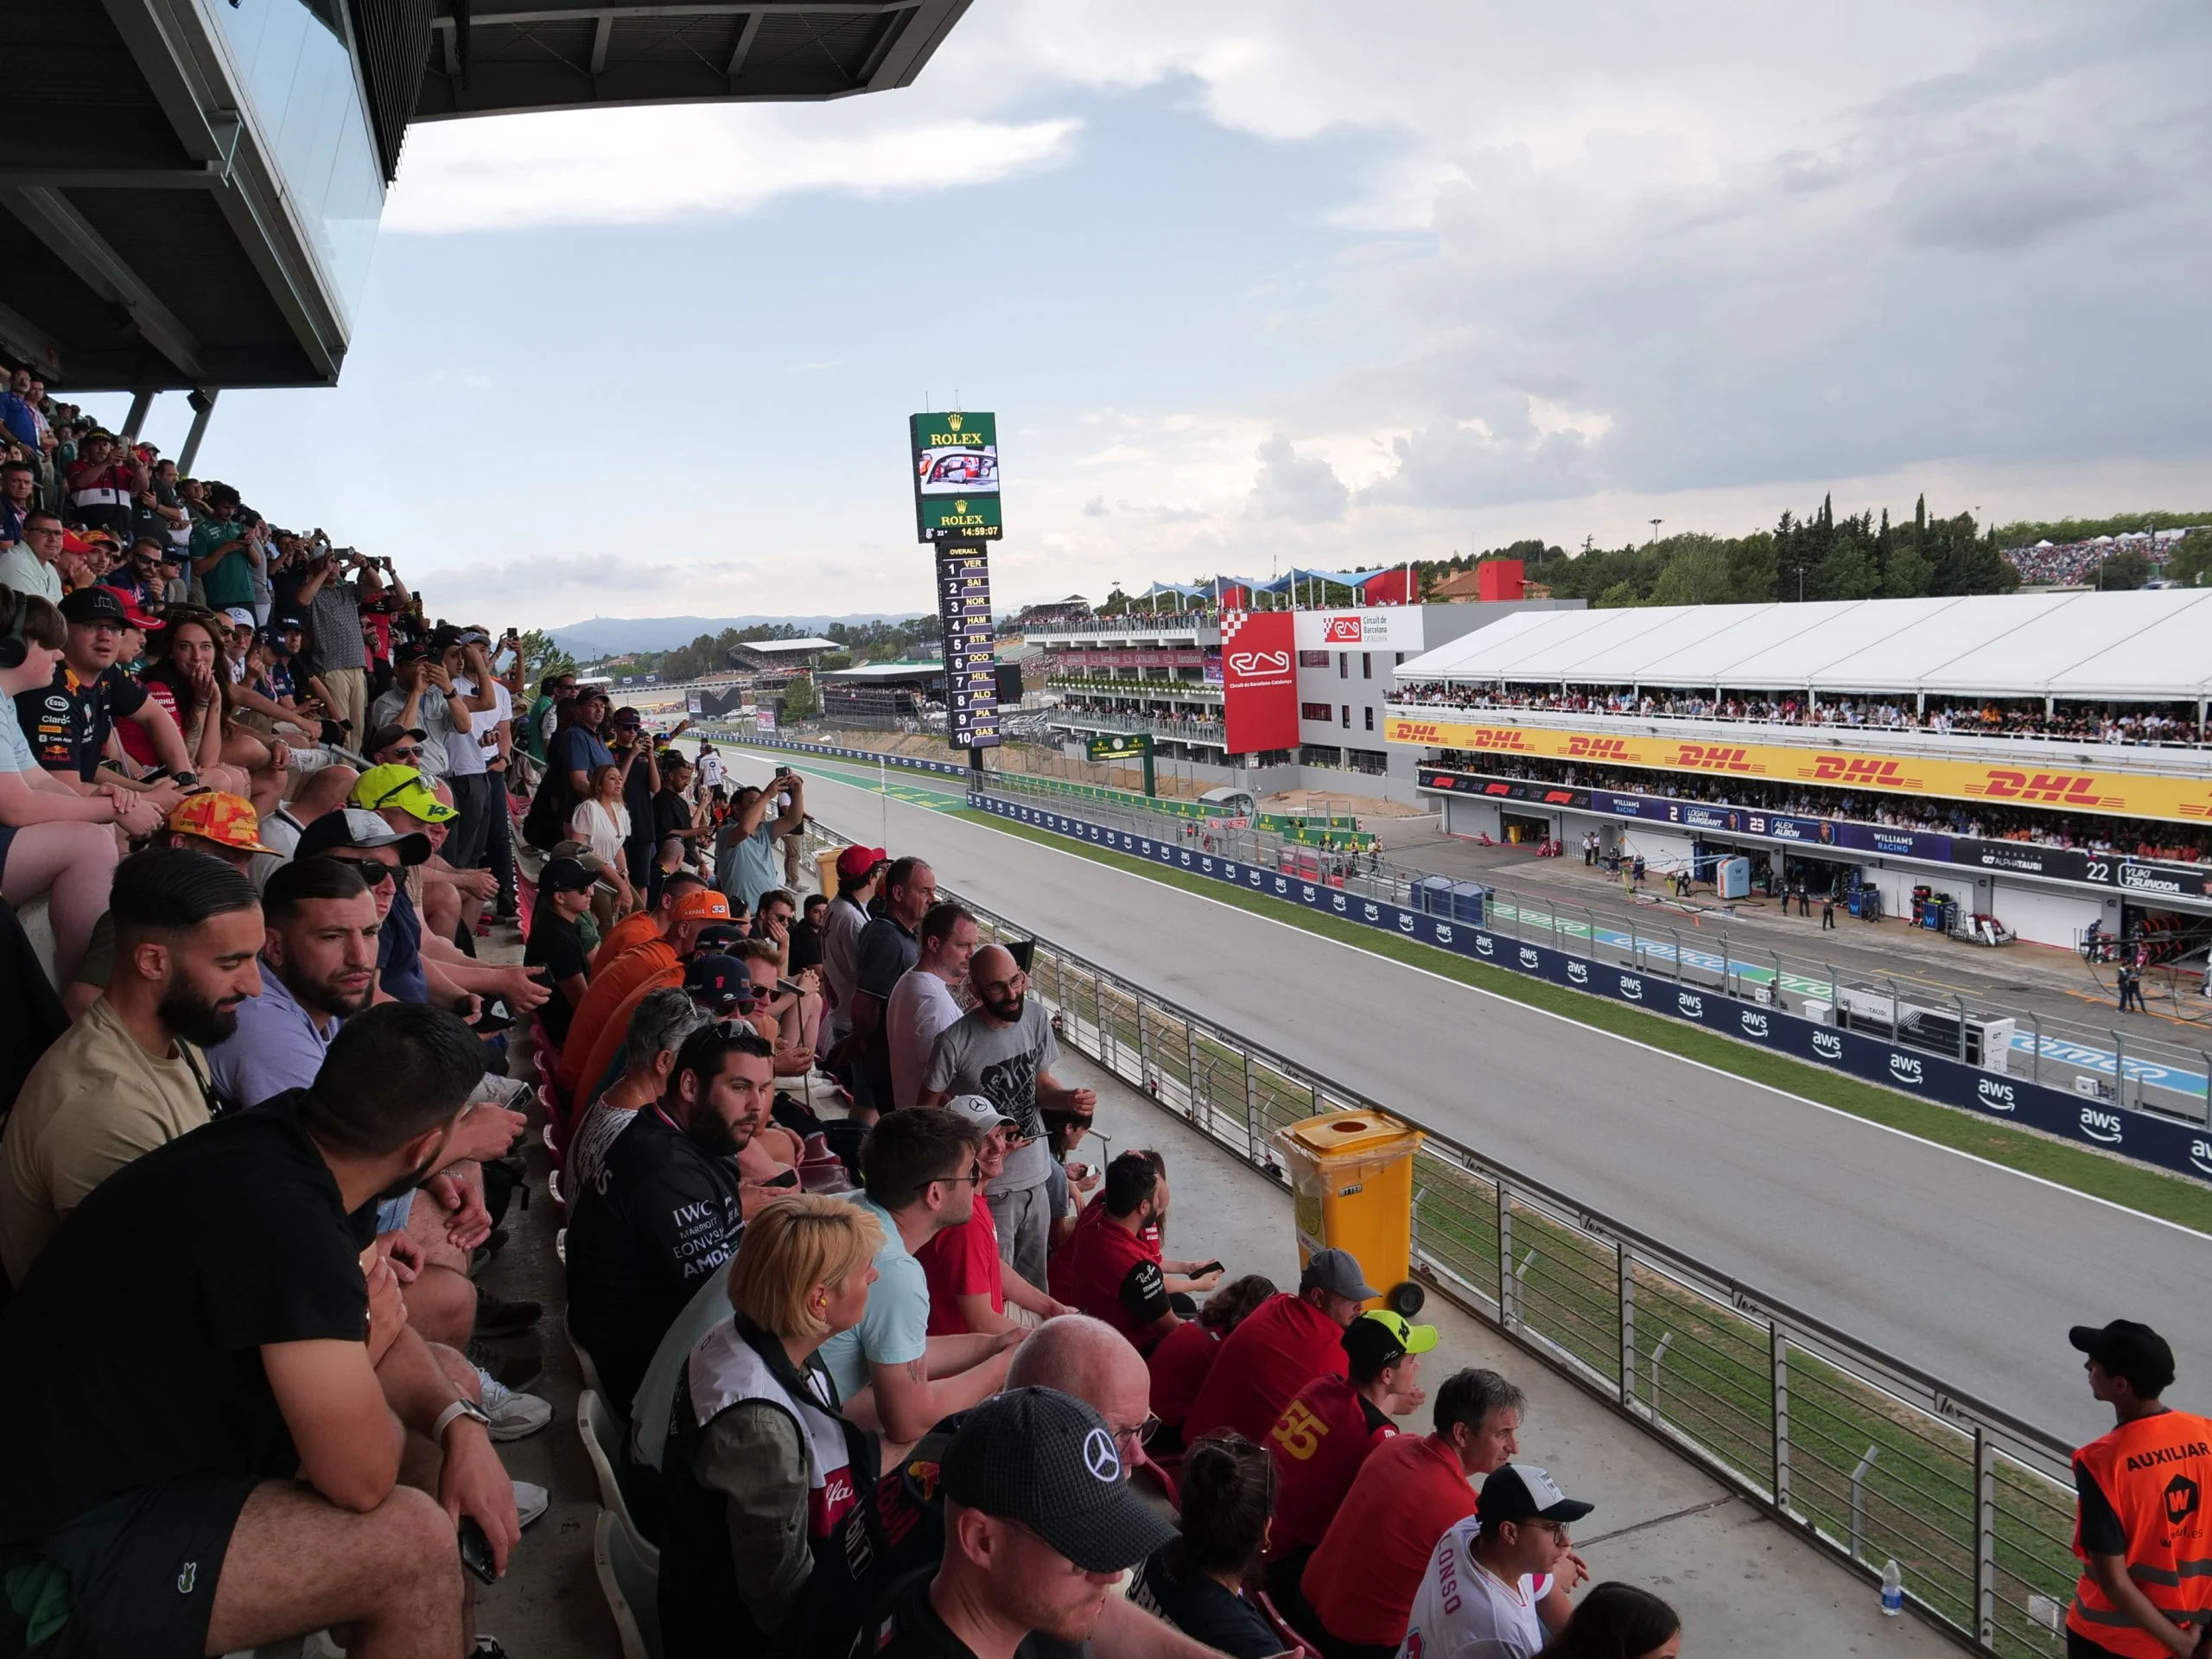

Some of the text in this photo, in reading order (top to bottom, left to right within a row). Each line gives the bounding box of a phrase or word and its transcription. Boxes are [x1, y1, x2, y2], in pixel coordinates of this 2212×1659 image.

[931, 434, 982, 445] ROLEX
[941, 515, 983, 525] ROLEX
[961, 527, 998, 536] 14:59:07
[949, 563, 954, 574] 1
[950, 583, 957, 594] 2
[950, 601, 958, 613] 3
[952, 620, 960, 631] 4
[954, 639, 961, 650] 5
[955, 658, 963, 669] 6
[956, 677, 963, 688] 7
[957, 696, 965, 706] 8
[41, 715, 67, 724] Claro
[958, 714, 966, 725] 9
[957, 733, 971, 743] 10
[1396, 723, 1440, 742] DHL
[1476, 729, 1525, 750] DHL
[1568, 736, 1629, 760] DHL
[1677, 745, 1751, 771] DHL
[1814, 756, 1905, 786] DHL
[1985, 771, 2101, 805] DHL
[1613, 798, 1640, 808] WILLIAMS
[427, 804, 449, 816] 14
[1669, 807, 1677, 821] 2
[1688, 809, 1709, 817] LOGAN
[1688, 817, 1723, 827] SARGEANT
[1750, 817, 1764, 832] 23
[1774, 821, 1794, 830] ALEX
[1774, 828, 1800, 838] ALBON
[1873, 833, 1913, 846] WILLIAMS
[1878, 842, 1909, 853] RACING
[1995, 857, 2043, 871] ALPHATAURI
[1250, 871, 1260, 880] aws
[2087, 862, 2108, 881] 22
[2126, 867, 2152, 878] YUKI
[1275, 878, 1286, 888] aws
[2126, 876, 2180, 892] TSUNODA
[1304, 886, 1315, 896] aws
[1333, 894, 1345, 906] aws
[1365, 904, 1378, 915] aws
[1400, 913, 1414, 925] aws
[1437, 924, 1452, 936] aws
[1476, 935, 1492, 949] aws
[1520, 947, 1538, 962] aws
[1567, 961, 1586, 976] aws
[715, 976, 724, 988] 1
[1620, 976, 1641, 991] aws
[1678, 993, 1702, 1009] aws
[1742, 1011, 1767, 1028] aws
[1813, 1031, 1840, 1050] aws
[1891, 1054, 1922, 1075] aws
[1979, 1079, 2014, 1102] aws
[2081, 1109, 2120, 1132] aws
[2191, 1141, 2212, 1160] aw
[672, 1200, 714, 1227] IWC
[680, 1217, 717, 1239] MARRIOTT
[684, 1249, 724, 1279] AMD
[1398, 1319, 1410, 1343] 14
[1271, 1399, 1330, 1459] 55
[2126, 1441, 2211, 1472] AUXILIAR
[826, 1479, 854, 1512] lfa
[1438, 1532, 1461, 1615] LONSO
